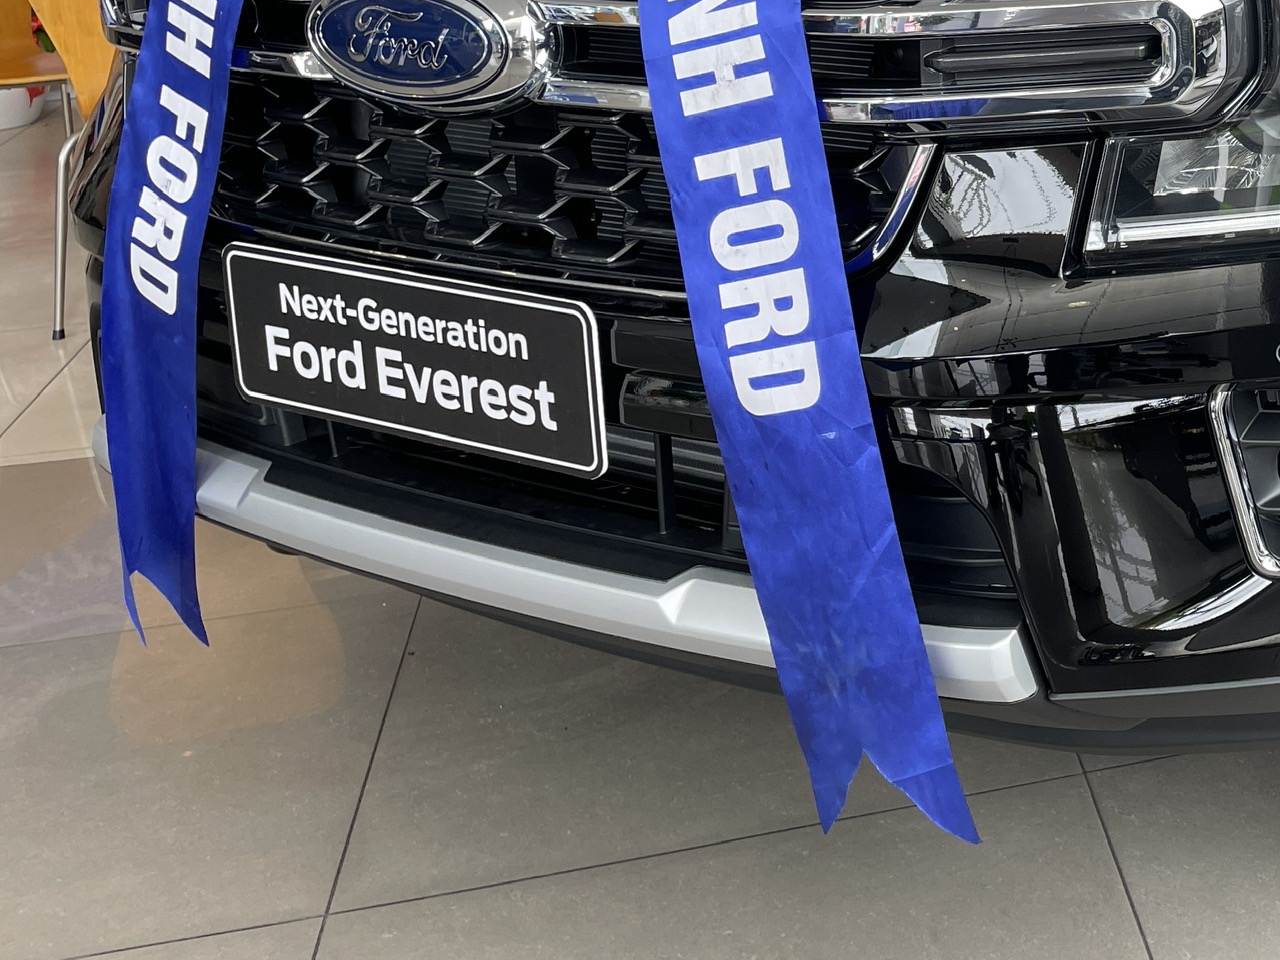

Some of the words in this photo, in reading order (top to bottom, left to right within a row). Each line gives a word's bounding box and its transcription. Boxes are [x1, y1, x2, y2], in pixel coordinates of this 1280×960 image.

[347, 4, 450, 70] Ford
[131, 84, 209, 316] FORD
[279, 282, 529, 361] Next-Generation
[694, 136, 822, 417] FORD
[264, 324, 367, 391] Ford
[375, 346, 558, 432] Everest
